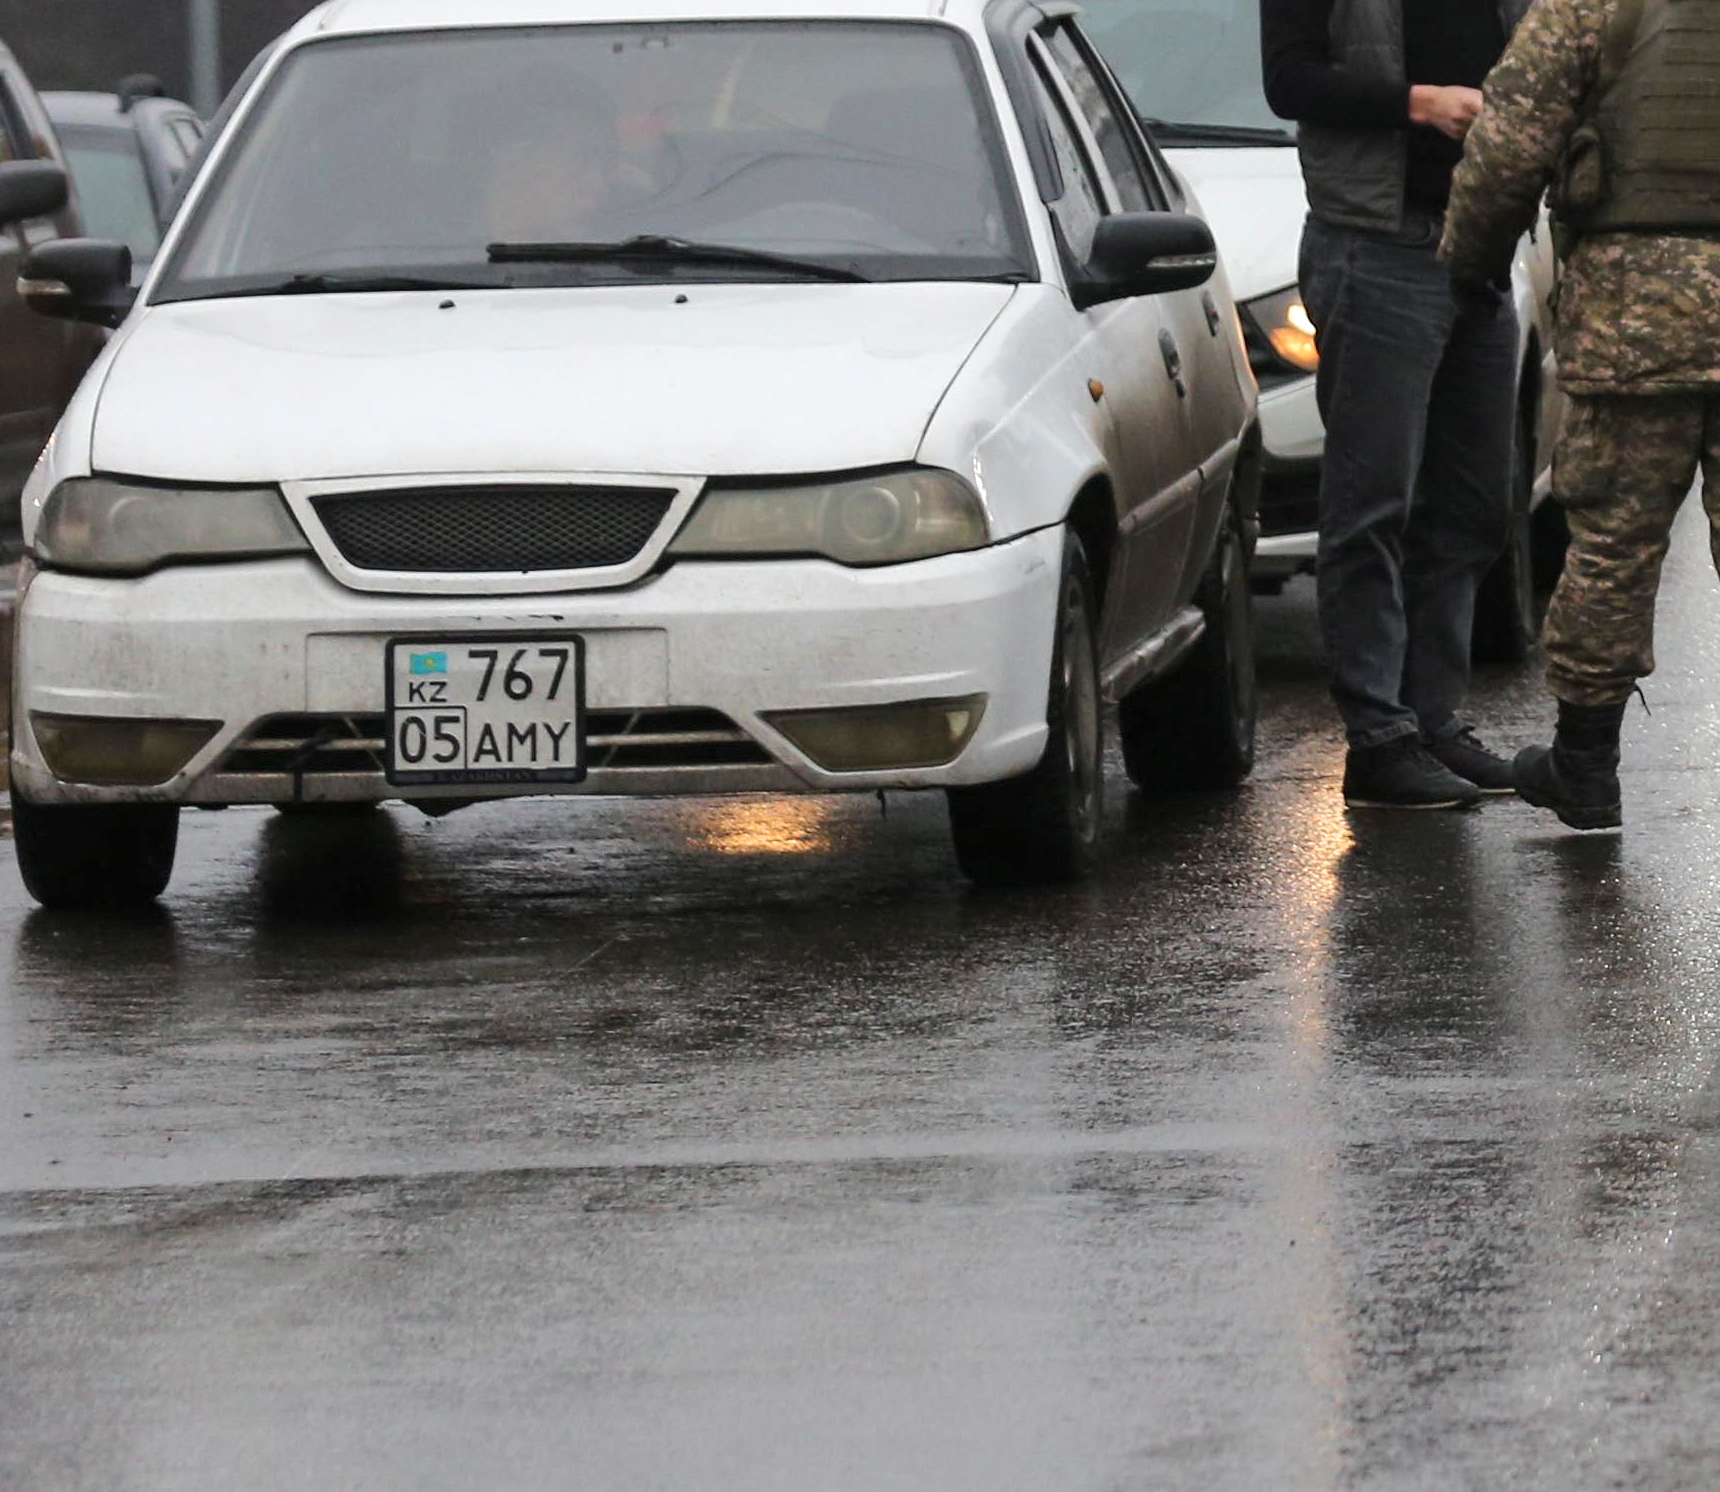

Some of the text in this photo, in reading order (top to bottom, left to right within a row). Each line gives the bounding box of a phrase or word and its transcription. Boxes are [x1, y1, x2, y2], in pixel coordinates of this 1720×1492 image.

[409, 649, 569, 703] KZ 767
[400, 716, 572, 764] 05 AMY
